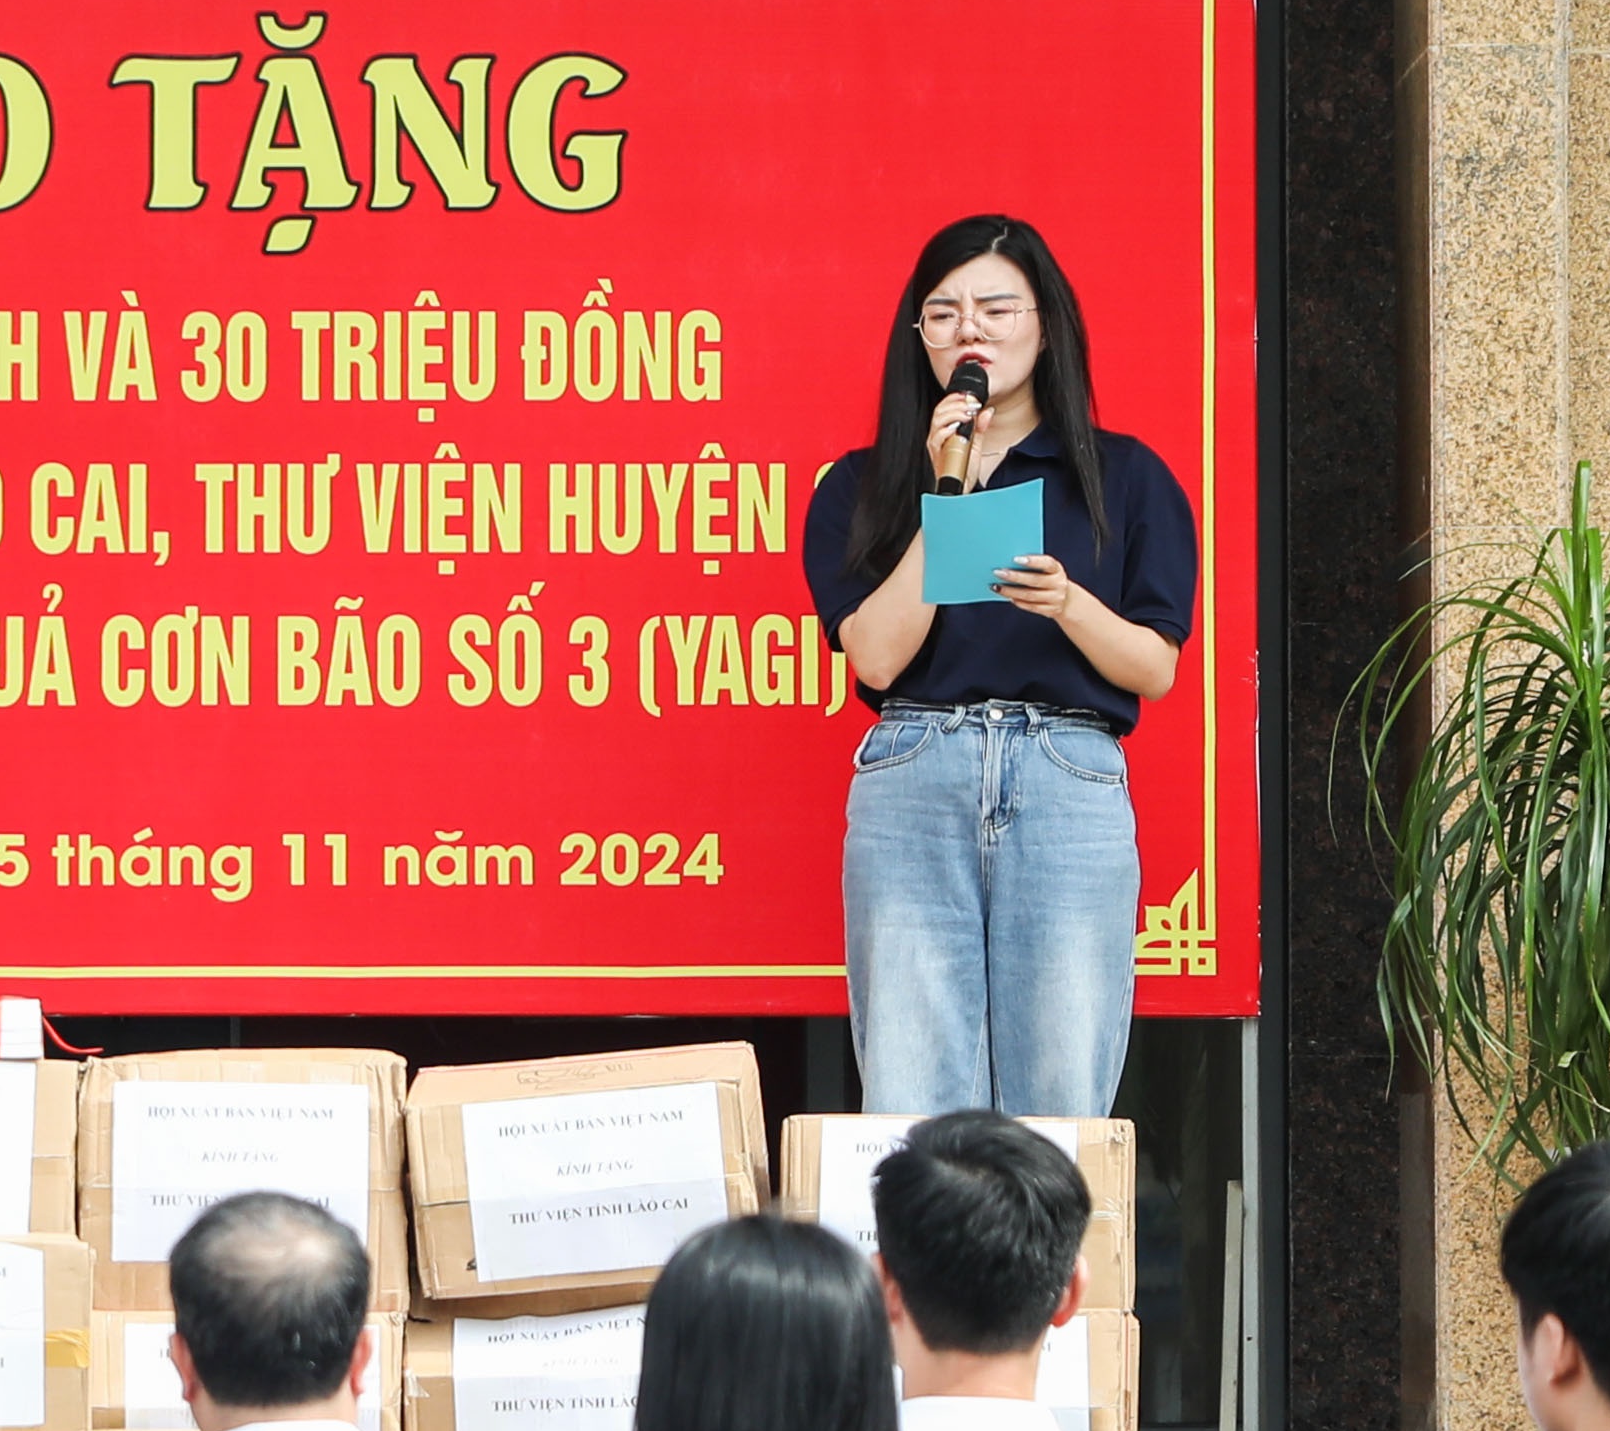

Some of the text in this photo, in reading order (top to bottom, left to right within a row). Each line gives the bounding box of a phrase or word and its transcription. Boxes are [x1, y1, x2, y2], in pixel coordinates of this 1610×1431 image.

[112, 14, 624, 252] TẶNG
[64, 290, 157, 401] VÀ
[181, 311, 267, 402] 30
[291, 290, 497, 422] TRIỆU
[521, 279, 722, 402] ĐỒNG
[31, 462, 170, 566] CAI,
[195, 453, 341, 554] THƯ
[356, 443, 522, 575] VIỆN
[549, 442, 787, 575] HUYỆN
[101, 605, 250, 707] CƠN
[277, 596, 421, 707] BÃO
[448, 581, 544, 707] SỐ
[568, 616, 610, 707] 3
[639, 614, 847, 717] (YAGI)
[51, 828, 253, 902] tháng
[282, 834, 347, 886] 11
[384, 831, 534, 886] năm
[560, 833, 724, 886] 2024
[648, 1108, 684, 1124] NAM
[508, 1209, 543, 1226] THƯ
[545, 1205, 583, 1224] VIỆN
[626, 1194, 659, 1215] LÀO
[661, 1196, 690, 1212] CAI
[491, 1396, 526, 1413] THƯ
[529, 1396, 565, 1413] VIỆN
